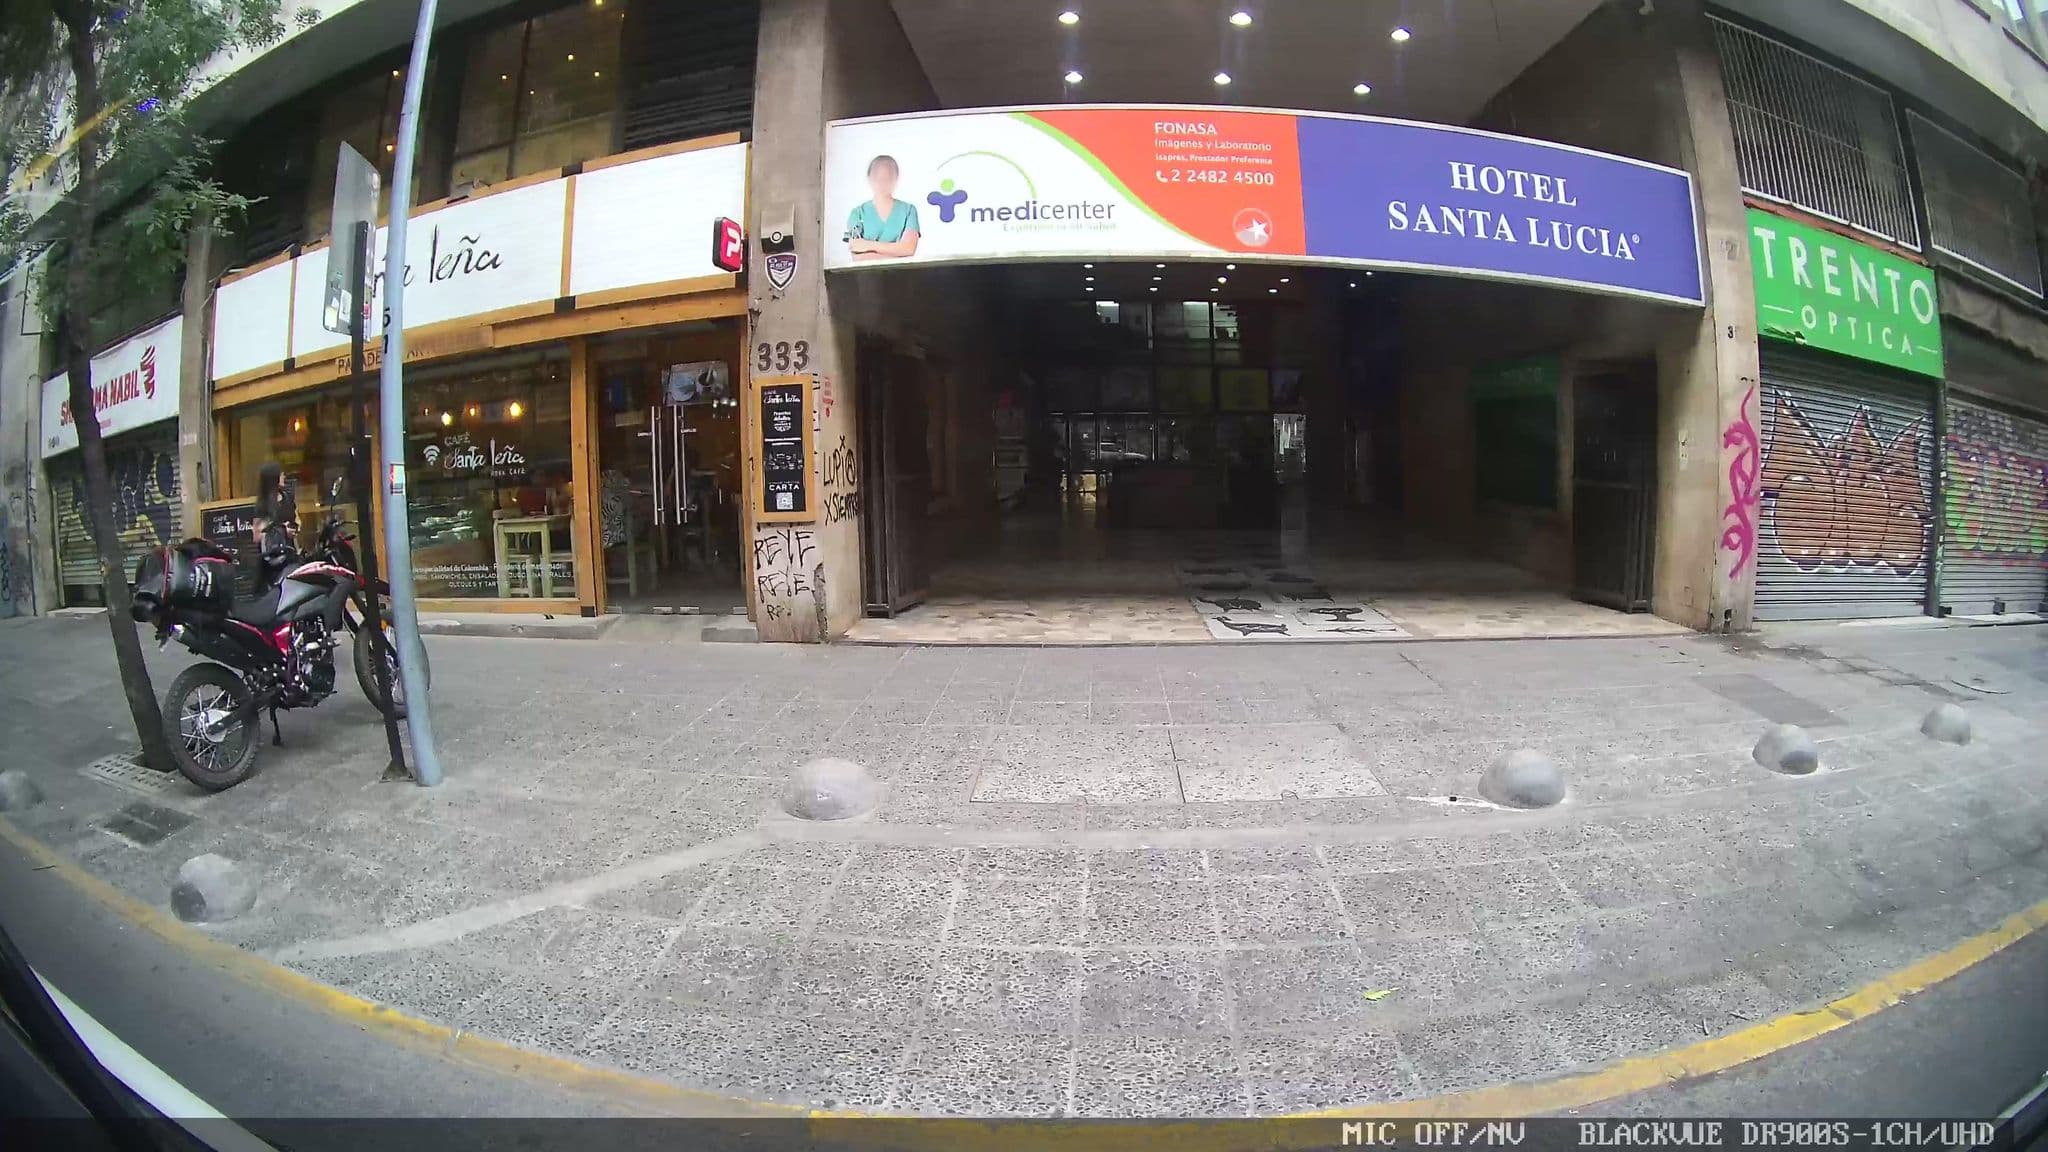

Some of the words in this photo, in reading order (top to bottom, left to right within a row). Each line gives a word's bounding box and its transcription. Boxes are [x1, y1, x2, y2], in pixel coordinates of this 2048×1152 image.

[1154, 121, 1218, 136] FONASA
[1205, 142, 1213, 151] y
[1214, 140, 1273, 152] Laboratorio
[1171, 169, 1181, 183] 2
[1187, 170, 1228, 184] 2482
[1233, 172, 1275, 186] 4500
[1448, 161, 1578, 207] HOTEL
[970, 199, 1116, 224] medicenter
[1388, 200, 1518, 243] SANTA
[429, 224, 503, 284] leña
[1754, 226, 1936, 325] TRENTO
[1802, 304, 1914, 355] OPTICA
[757, 340, 810, 372] 333
[109, 370, 140, 407] NABIL
[444, 446, 486, 471] Santa
[768, 483, 800, 492] CARTA
[460, 563, 489, 572] Colombia
